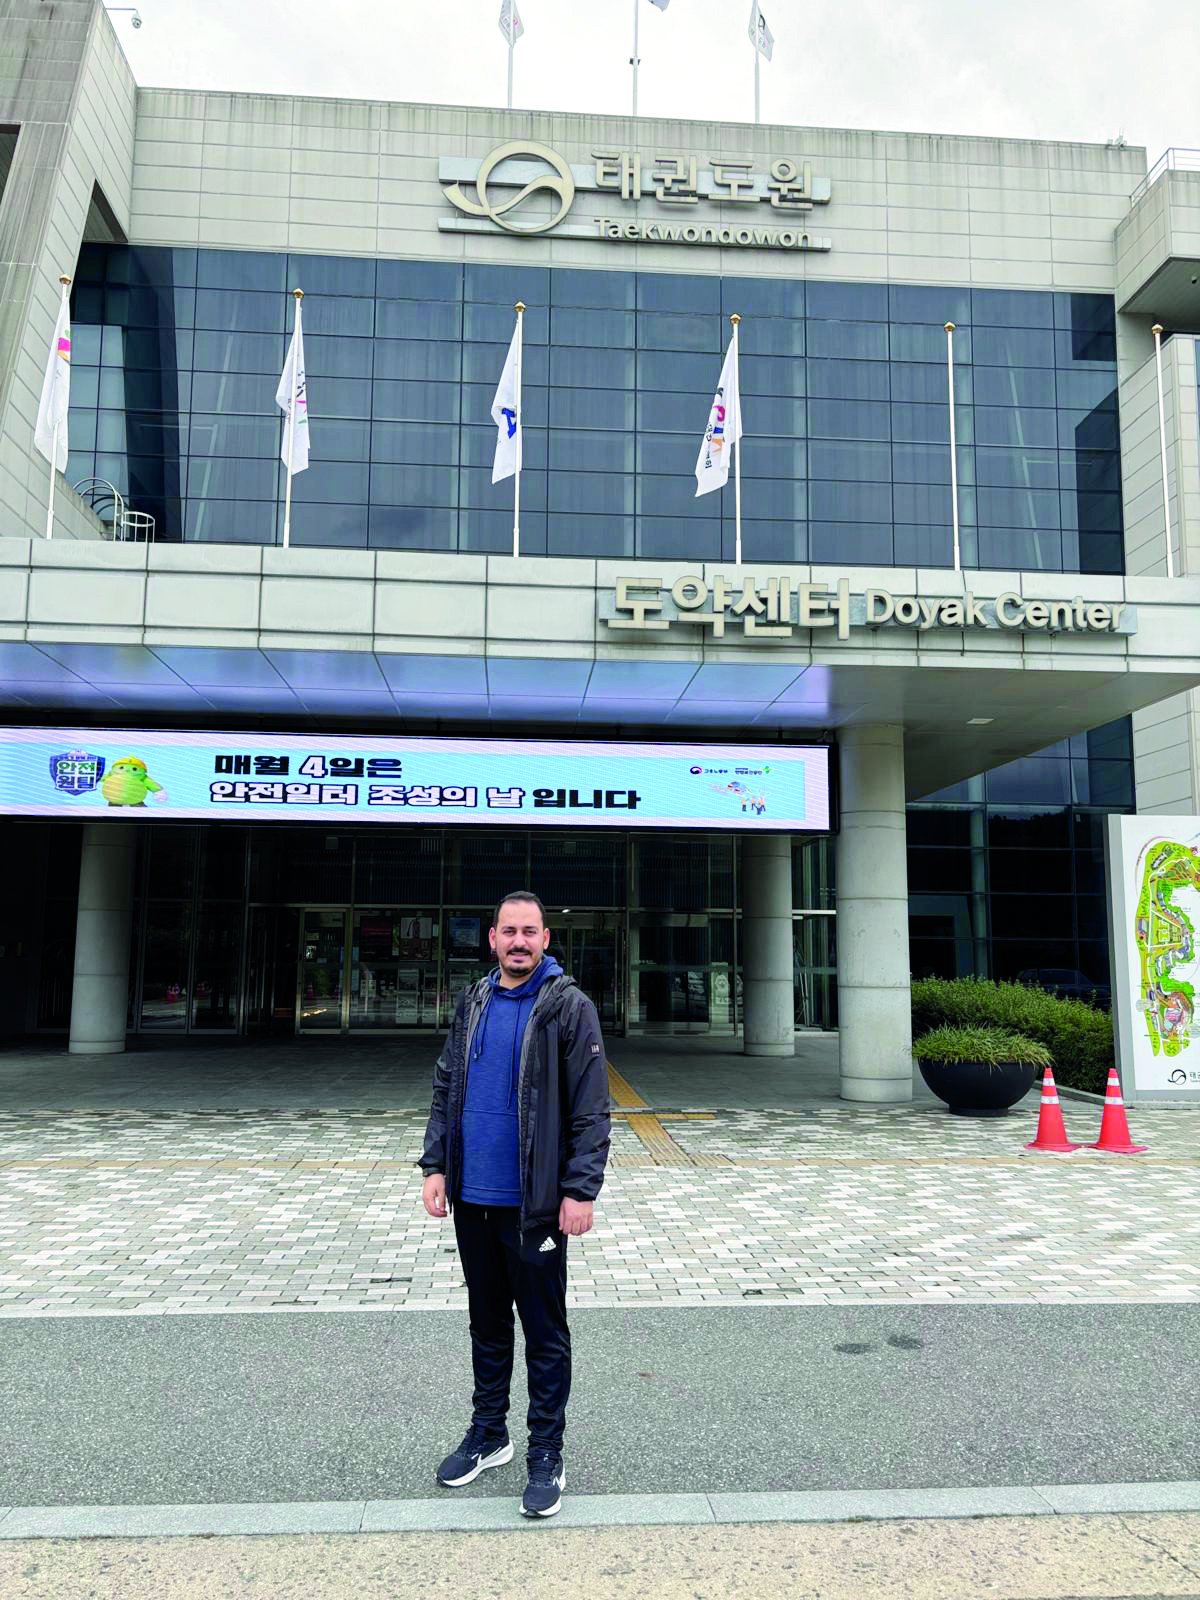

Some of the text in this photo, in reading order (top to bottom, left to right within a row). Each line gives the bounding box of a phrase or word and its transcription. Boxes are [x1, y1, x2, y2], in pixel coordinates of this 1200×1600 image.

[591, 152, 812, 211] 태권도원
[594, 218, 812, 247] Taekwondowon
[607, 575, 1126, 641] 도약센터 Doyak Center
[57, 760, 97, 775] 안전
[214, 754, 402, 778] 매월 4일은
[210, 781, 642, 810] 안전일터 조성의 날 입니다
